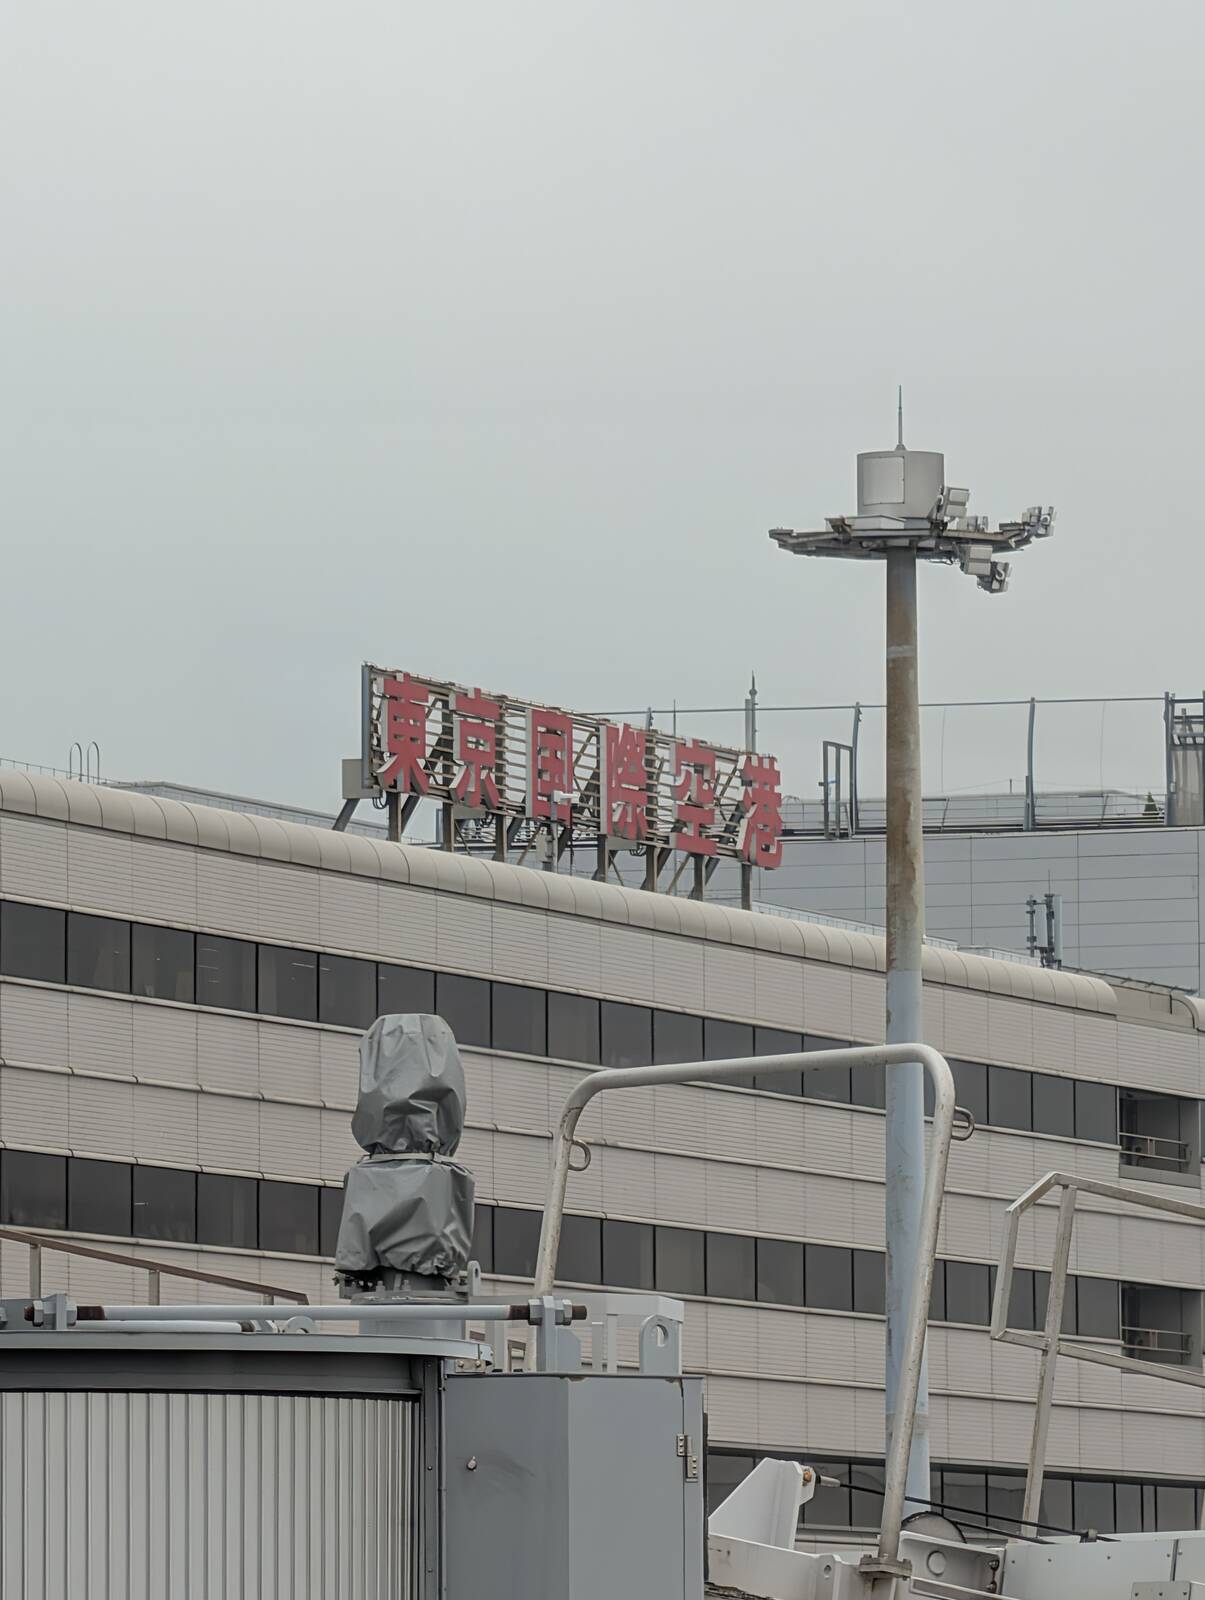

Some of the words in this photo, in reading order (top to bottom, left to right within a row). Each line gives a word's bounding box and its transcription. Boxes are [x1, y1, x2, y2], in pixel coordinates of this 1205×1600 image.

[379, 672, 783, 868] 東京国際空港
